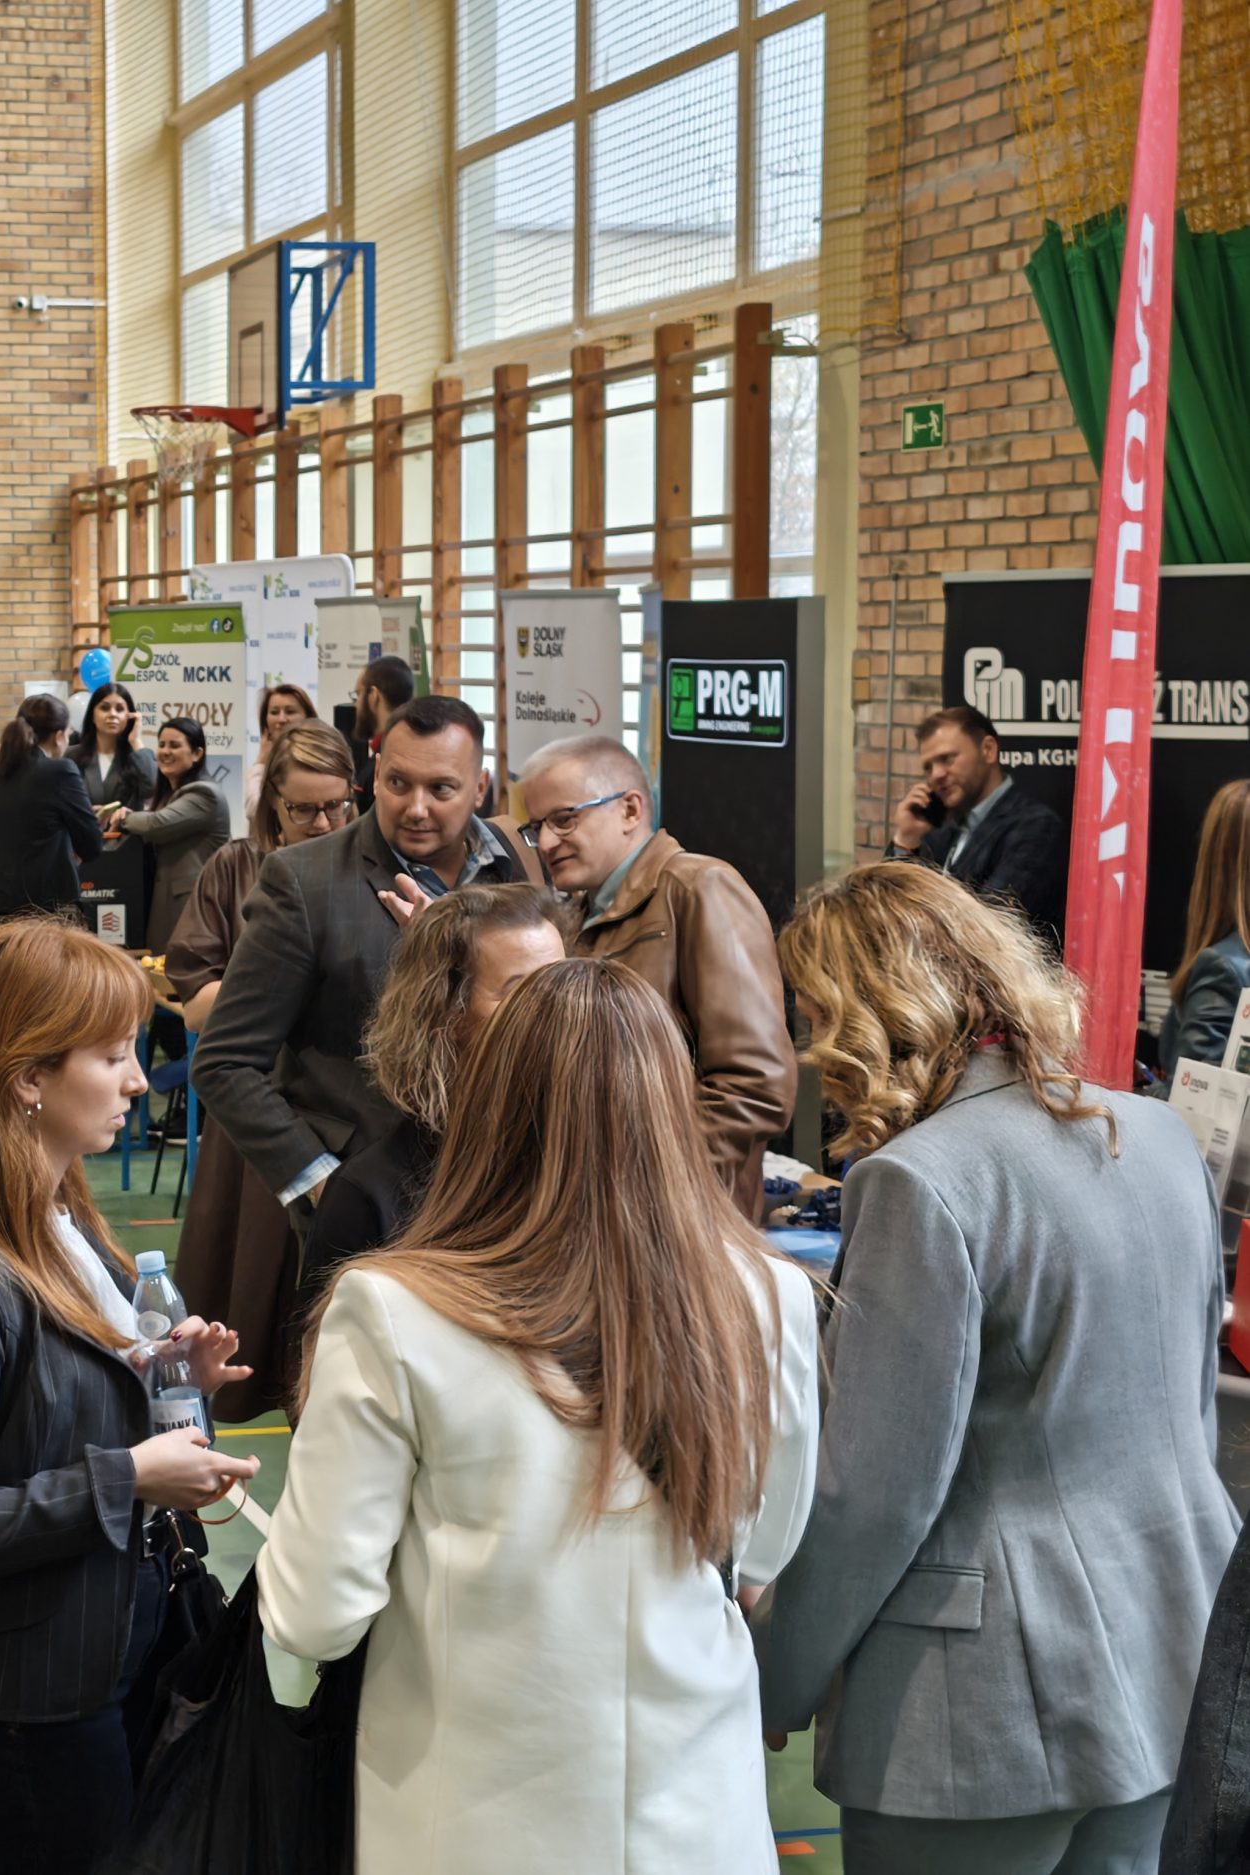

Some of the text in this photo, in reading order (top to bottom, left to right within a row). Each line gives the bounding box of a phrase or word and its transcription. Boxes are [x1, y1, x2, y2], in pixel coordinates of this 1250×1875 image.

[533, 626, 566, 641] DOLNY
[533, 641, 564, 659] ŚLĄSK
[183, 666, 232, 683] MCKK
[515, 690, 546, 708] Koleje
[697, 669, 783, 717] PRG-M
[1168, 680, 1249, 725] TRANS
[162, 702, 233, 727] SZKOŁY
[515, 706, 577, 724] Dolnośląskie
[1038, 747, 1078, 766] KGH
